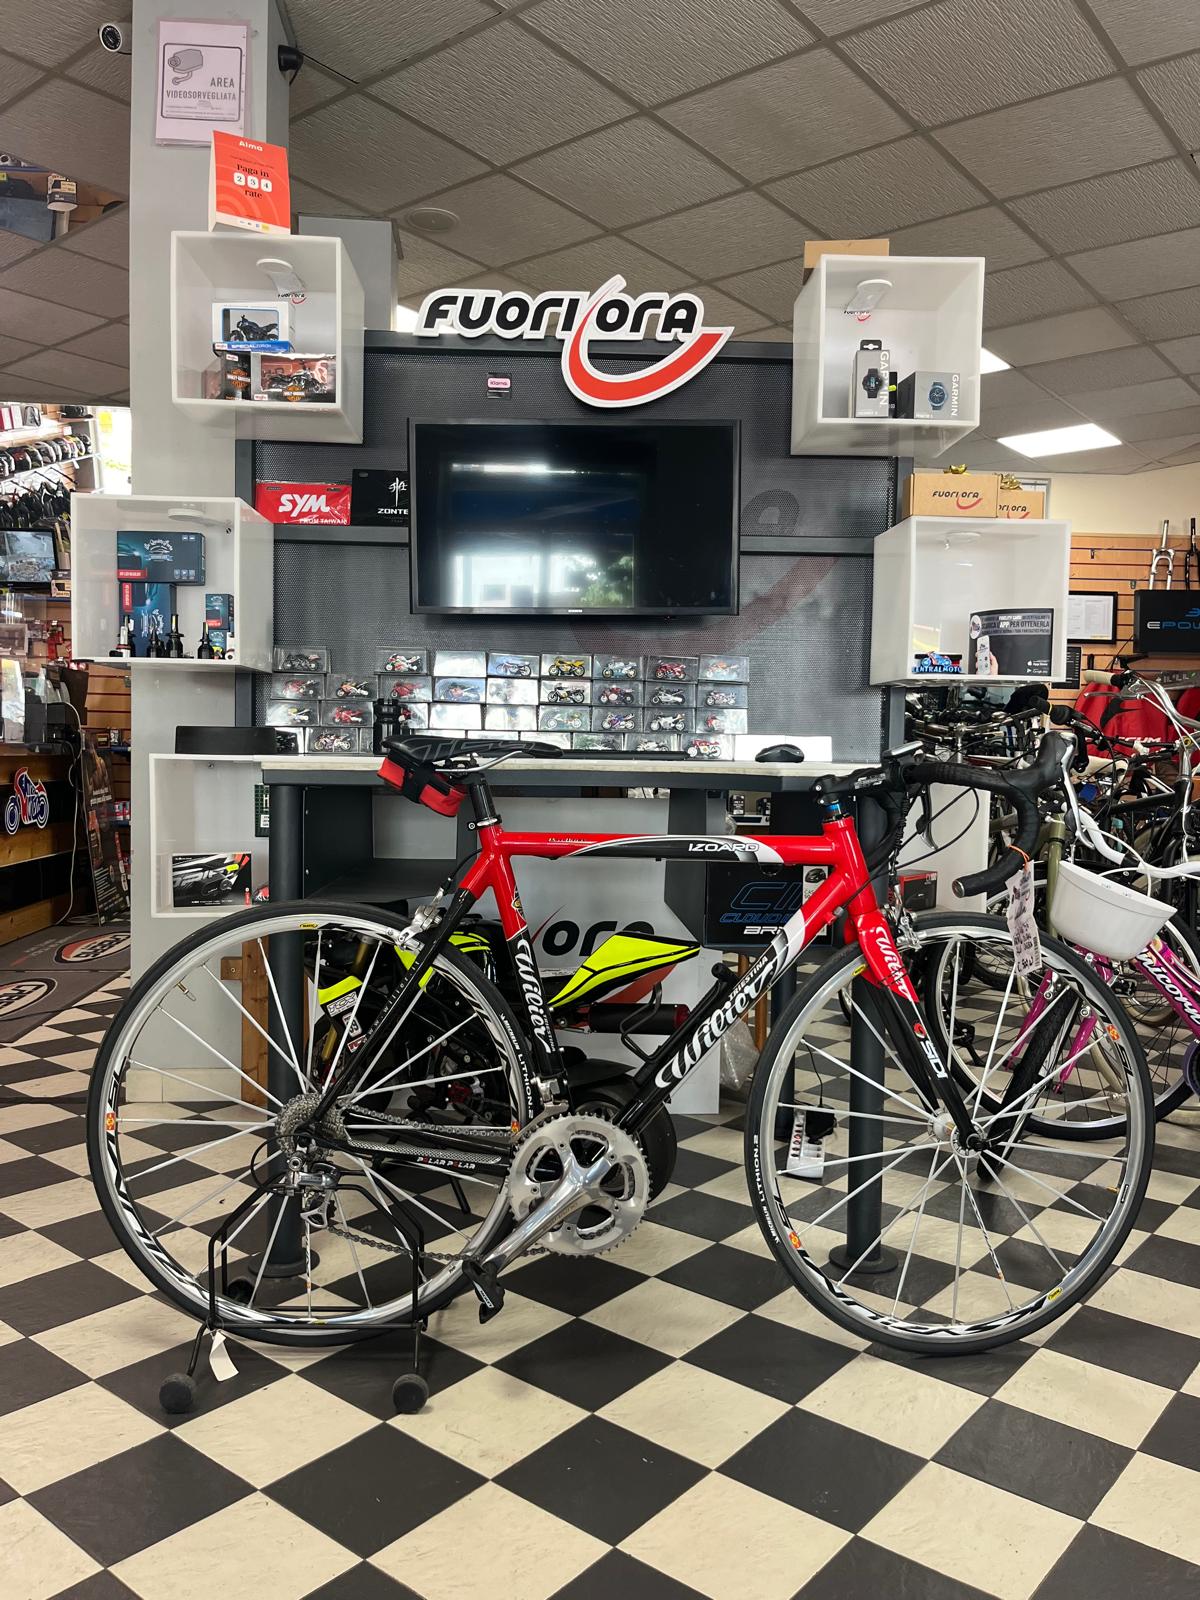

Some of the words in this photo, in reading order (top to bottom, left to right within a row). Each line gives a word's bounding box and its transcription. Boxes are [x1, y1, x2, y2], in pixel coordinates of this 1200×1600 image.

[210, 77, 235, 88] AREA
[166, 90, 236, 100] VIDEOSORVEGLIATA
[239, 140, 263, 152] Alma
[236, 163, 258, 175] Paga
[260, 168, 270, 178] in
[236, 175, 242, 183] 2
[250, 178, 256, 186] 3
[244, 189, 262, 199] rate
[951, 374, 960, 416] GARMIN
[278, 494, 330, 517] SYM
[1020, 620, 1050, 628] OTTENERLA
[688, 843, 759, 852] IZOARD
[876, 926, 914, 1002] Wilier
[728, 956, 769, 1000] TRIESTINA
[515, 938, 552, 1054] Wilier
[543, 1013, 556, 1053] TRIESTINA
[655, 959, 777, 1088] Wilier
[503, 1019, 520, 1050] MICHELIN
[518, 1053, 534, 1119] LITHION.2
[416, 1156, 446, 1166] POLAR
[447, 1159, 476, 1169] POLAR
[753, 1134, 765, 1202] LITHION.2
[762, 1205, 779, 1240] MICHELIN
